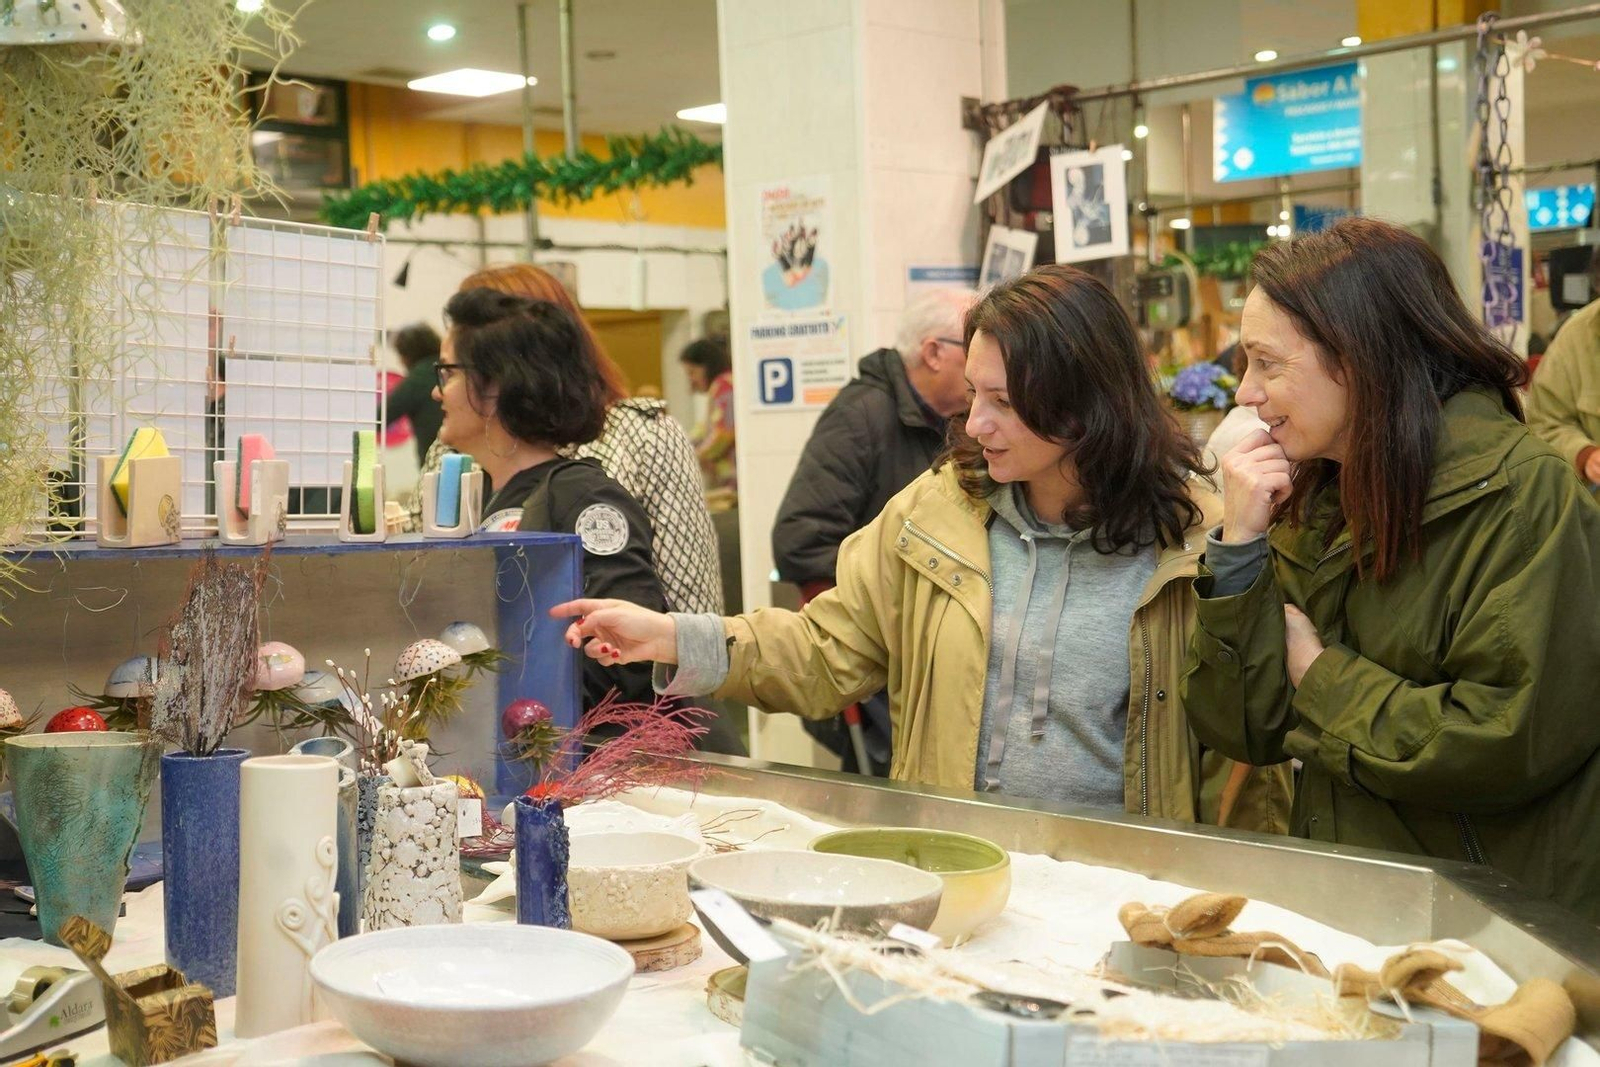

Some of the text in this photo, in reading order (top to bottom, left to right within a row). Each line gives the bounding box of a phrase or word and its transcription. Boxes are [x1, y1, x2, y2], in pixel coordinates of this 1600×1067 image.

[1277, 80, 1329, 101] Sabor
[1333, 75, 1348, 94] A
[750, 322, 829, 339] PARKING GRATUITO
[763, 361, 788, 402] P
